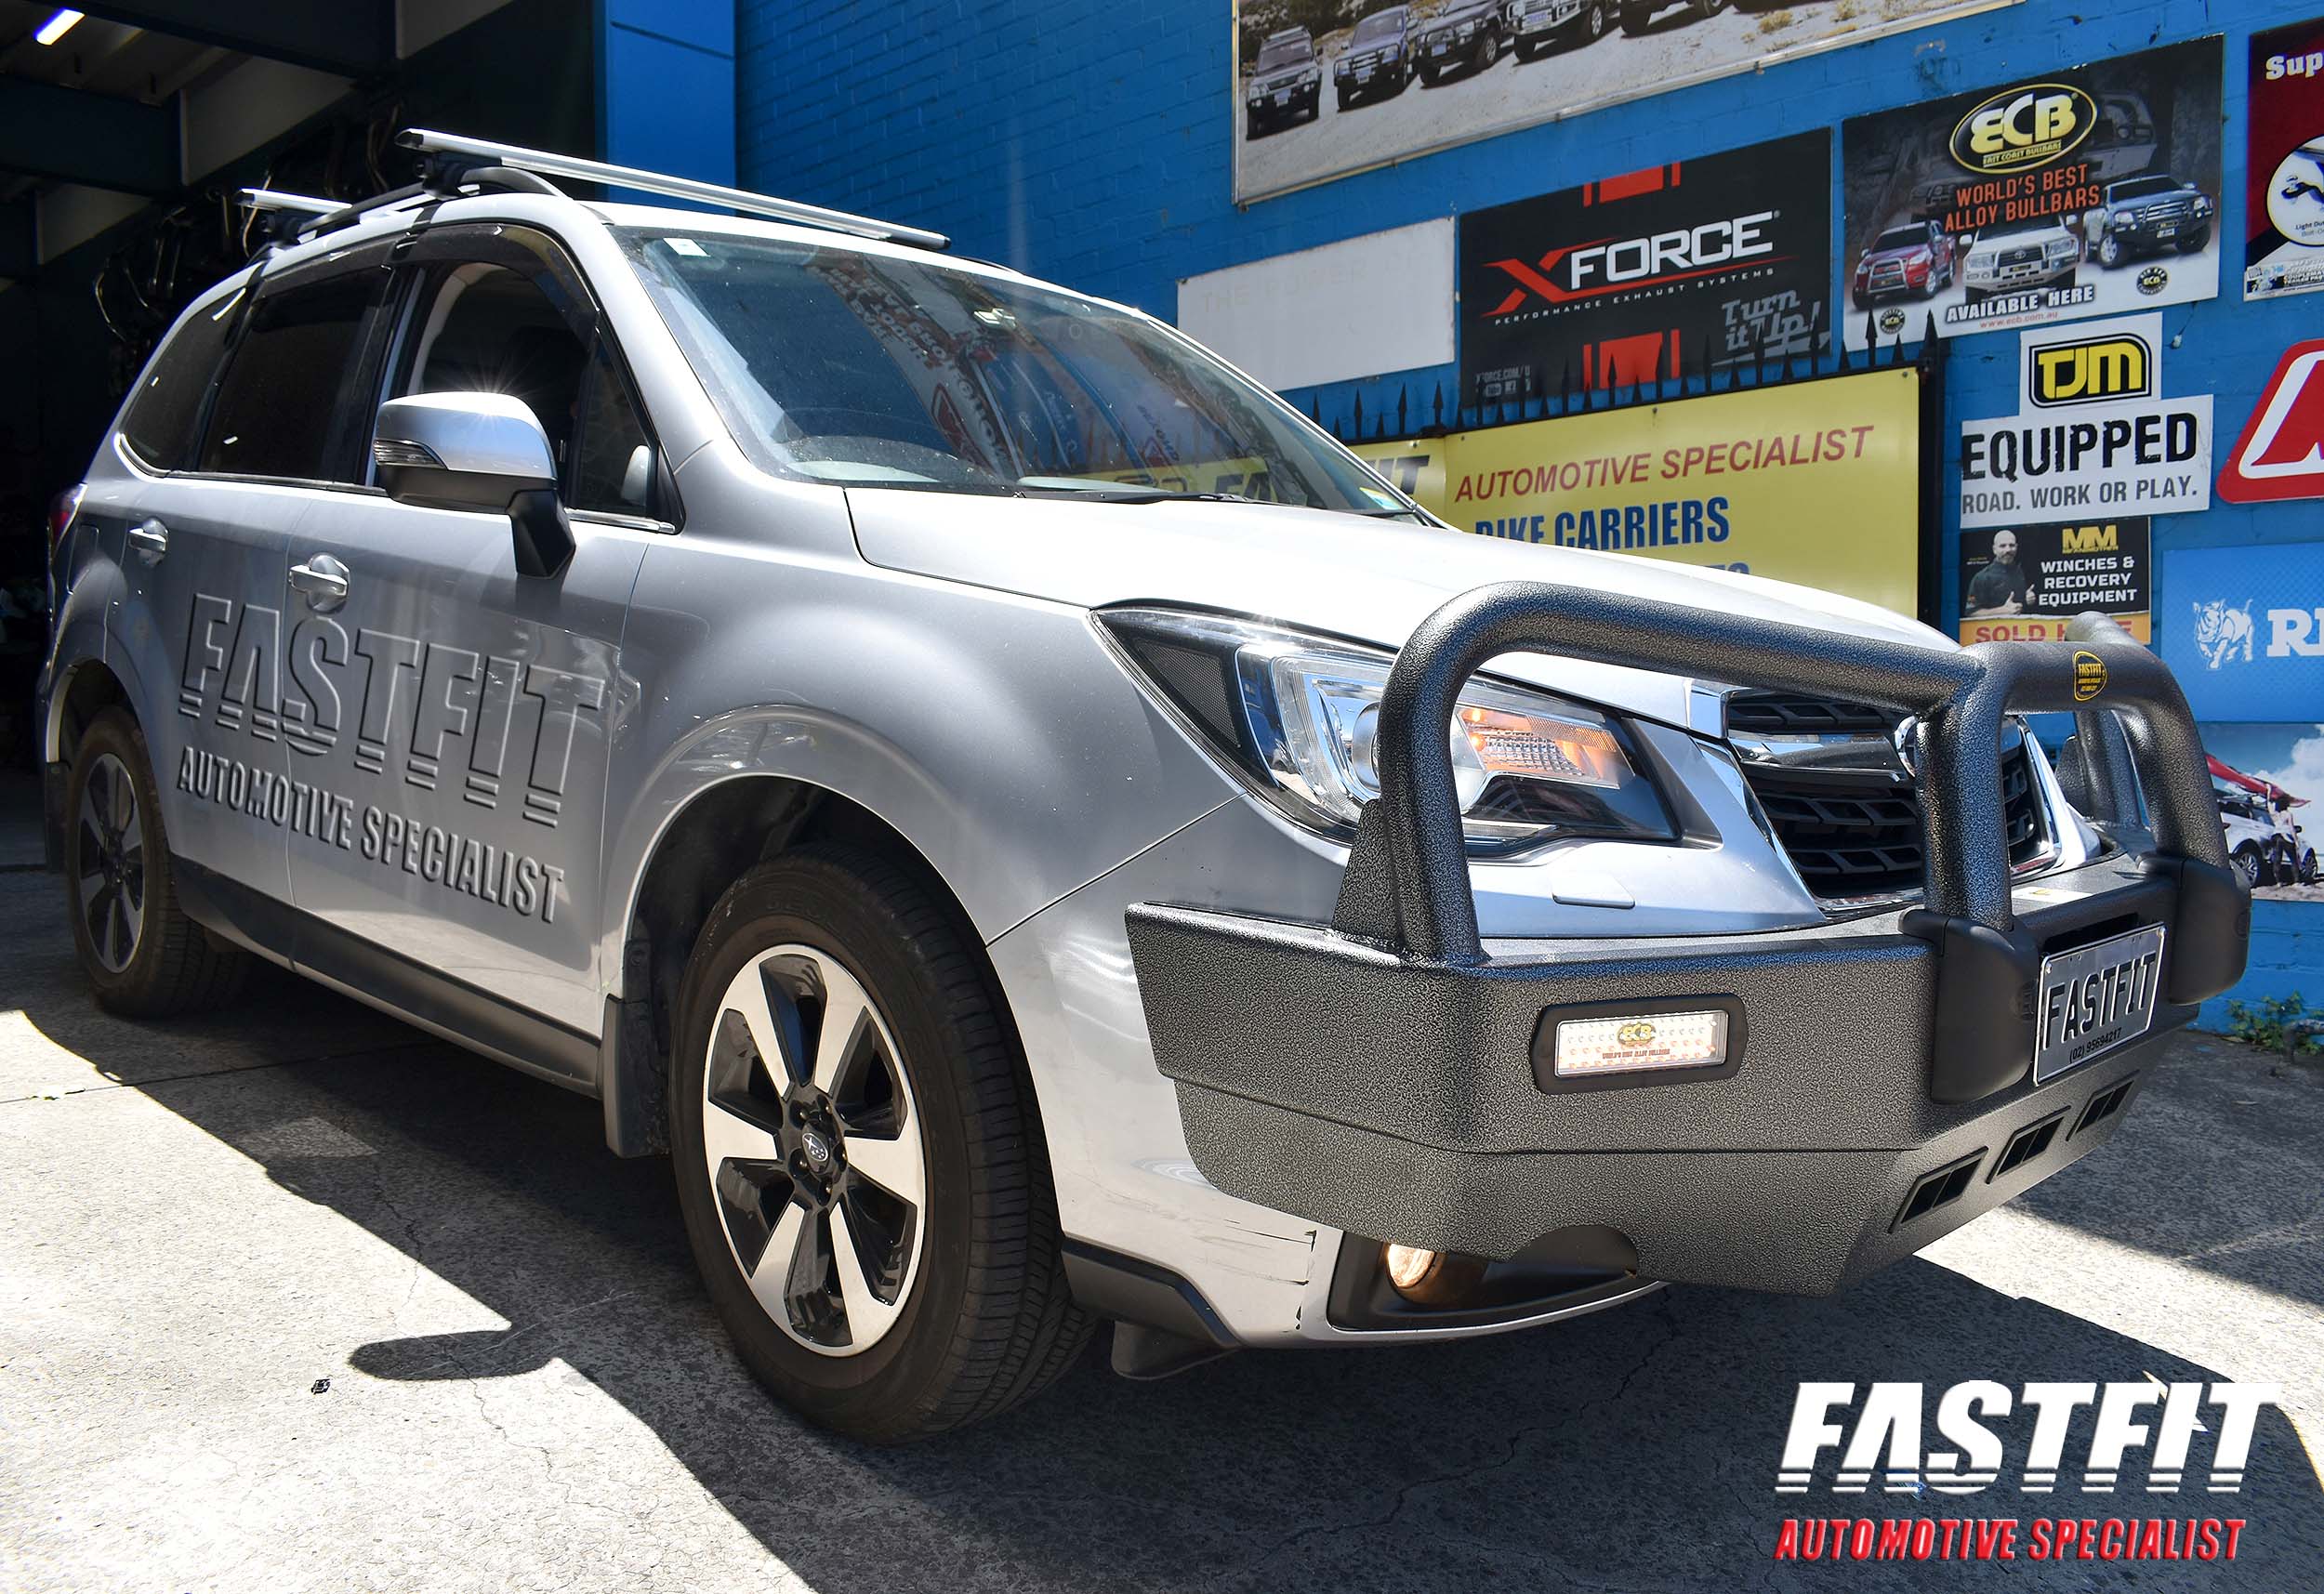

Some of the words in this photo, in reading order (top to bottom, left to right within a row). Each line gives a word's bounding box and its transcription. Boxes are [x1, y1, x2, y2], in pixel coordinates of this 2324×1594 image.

[1971, 94, 2076, 153] ECB
[1957, 175, 2036, 207] WORLD'S
[2042, 164, 2088, 191] BEST
[1945, 204, 1999, 232] ALLOY
[2006, 185, 2100, 221] BULLBARS
[1482, 210, 1774, 318] XFORCE
[1495, 299, 1602, 325] PERFORMANCE
[1613, 283, 1685, 304] EXHAUST
[1697, 268, 1775, 289] SYSTEMS
[1722, 290, 1801, 326] Turn
[1947, 293, 2039, 323] AVAILABLE
[2048, 284, 2094, 307] HERE
[1726, 325, 1750, 351] it
[1979, 310, 2059, 329] www.ecb.com.au
[2038, 341, 2142, 399] TJM
[1455, 454, 1651, 504] AUTOMOTIVE
[1660, 425, 1874, 479] SPECIALIST
[1962, 413, 2198, 482] EQUIPPED
[1962, 491, 2021, 514] ROAD.
[2030, 484, 2091, 509] WORK
[2099, 481, 2127, 503] OR
[2136, 475, 2198, 500] PLAY.
[1554, 495, 1730, 551] CARRIERS
[2040, 557, 2118, 573] WINCHES
[2122, 556, 2135, 569] &
[2044, 573, 2133, 590] RECOVERY
[2038, 588, 2138, 608] EQUIPMENT
[1975, 624, 2047, 642] SOLD
[178, 592, 606, 828] FASTFIT
[177, 745, 354, 851] AUTOMOTIVE
[361, 805, 565, 924] SPECIALIST
[2042, 950, 2157, 1051] FASTFIT
[2069, 1045, 2085, 1064] (02)
